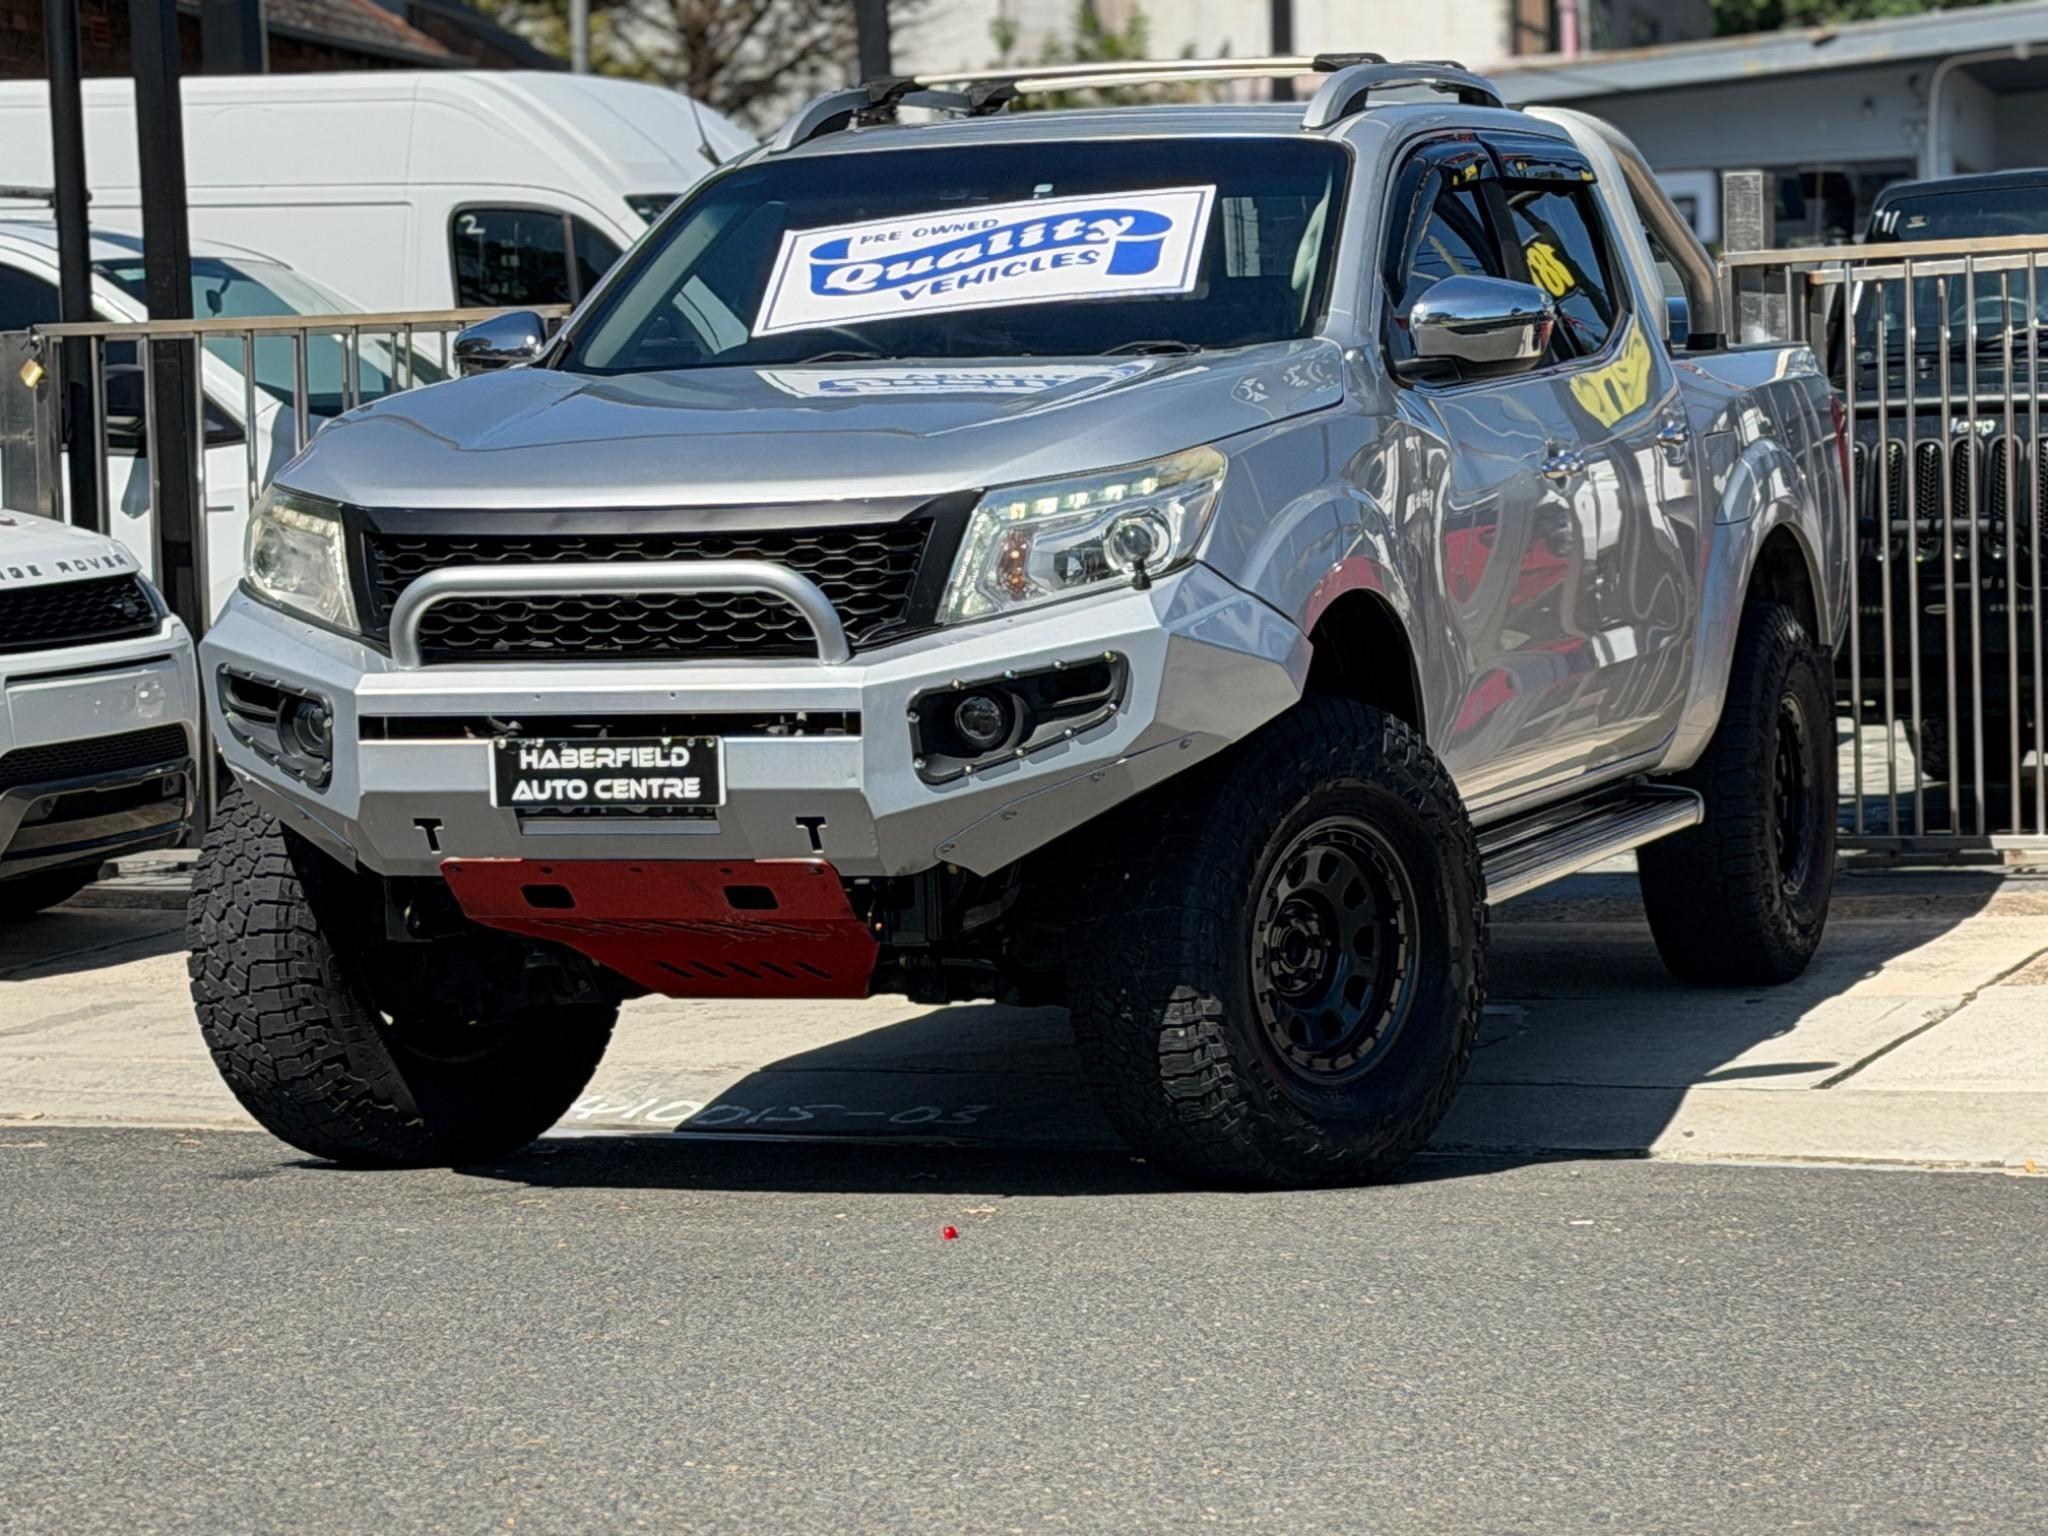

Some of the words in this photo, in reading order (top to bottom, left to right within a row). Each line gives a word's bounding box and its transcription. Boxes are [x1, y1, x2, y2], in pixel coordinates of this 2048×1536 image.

[459, 214, 487, 235] 2
[859, 230, 901, 246] PRE
[912, 218, 999, 239] OWNED
[822, 213, 1136, 291] Quality
[898, 248, 1101, 301] VEHICLES
[55, 553, 128, 573] ROVER
[519, 746, 691, 770] HABERFIELD
[512, 778, 588, 801] AUTO
[593, 777, 701, 799] CENTRE
